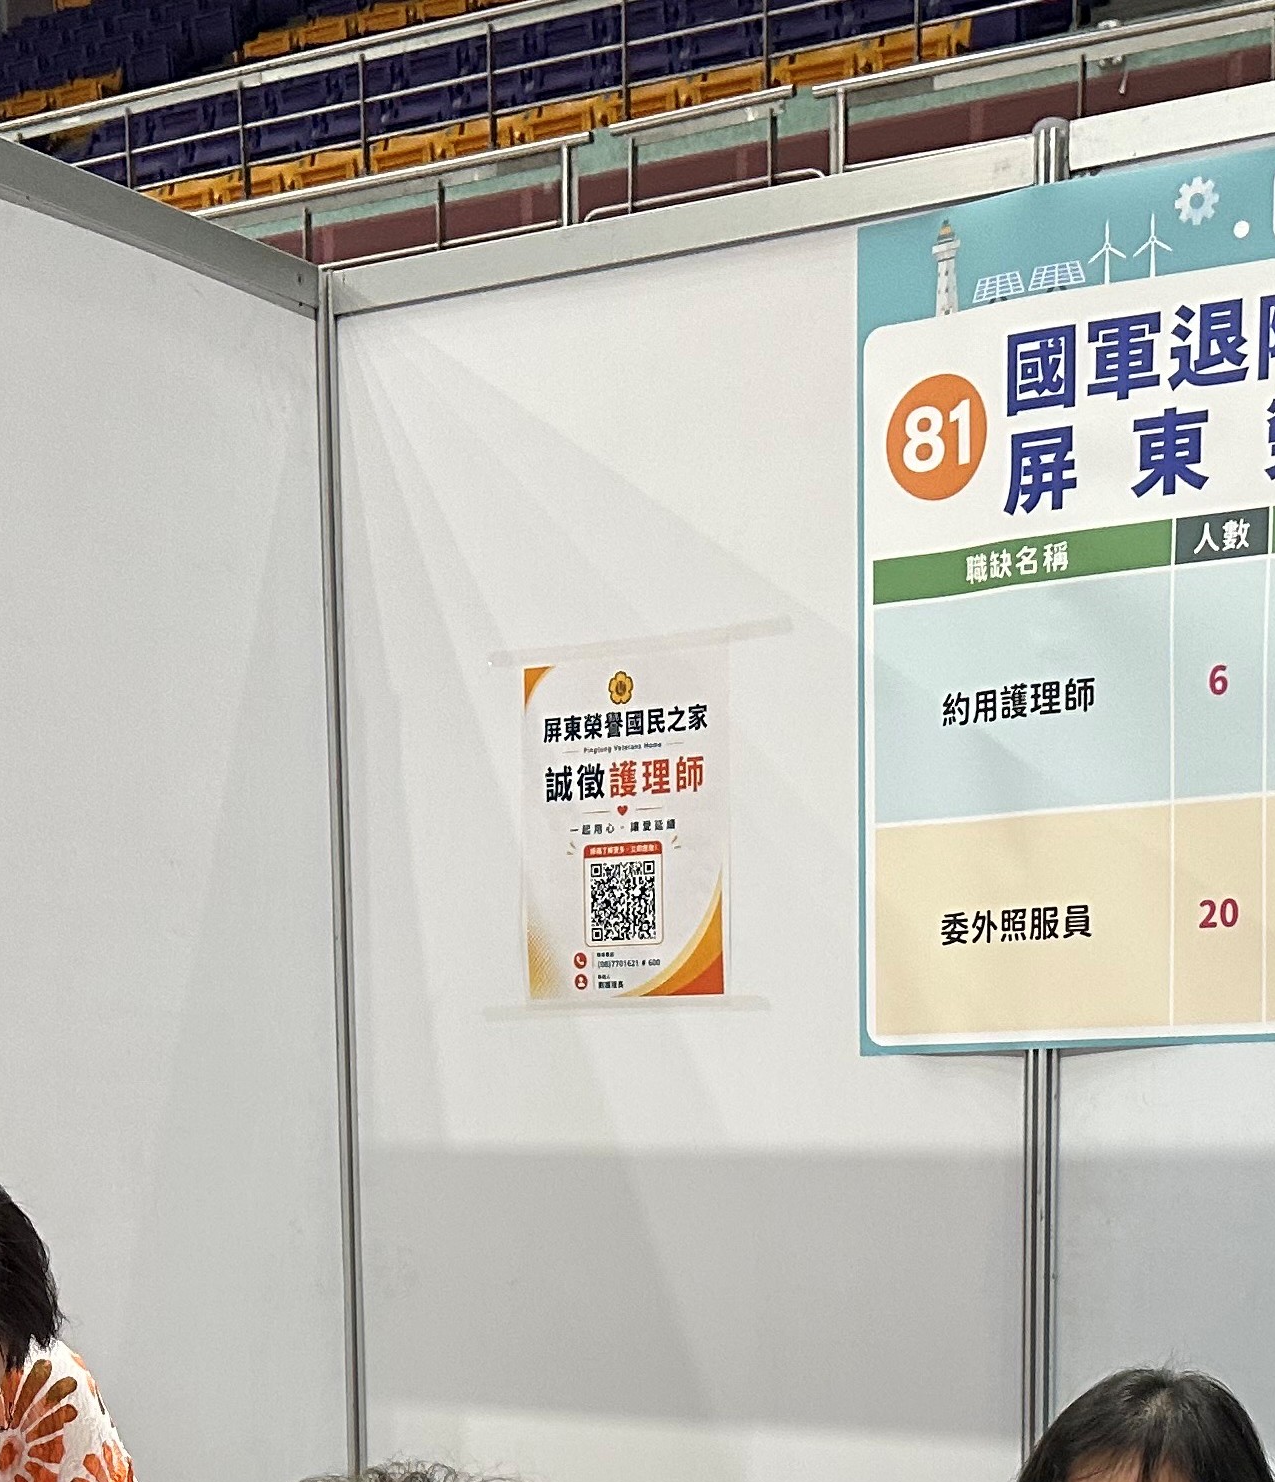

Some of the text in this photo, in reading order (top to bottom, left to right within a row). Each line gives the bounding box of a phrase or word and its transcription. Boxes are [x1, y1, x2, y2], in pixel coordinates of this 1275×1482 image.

[902, 399, 972, 473] 81
[1193, 520, 1252, 554] 人數
[966, 539, 1069, 584] 職缺名稱
[1208, 665, 1228, 695] 6
[543, 703, 708, 743] 屏東榮譽國民之家
[941, 677, 1096, 728] 約用護理師
[545, 755, 705, 802] 誠徵護理師
[941, 905, 1093, 947] 委外照服員
[1198, 900, 1239, 930] 20
